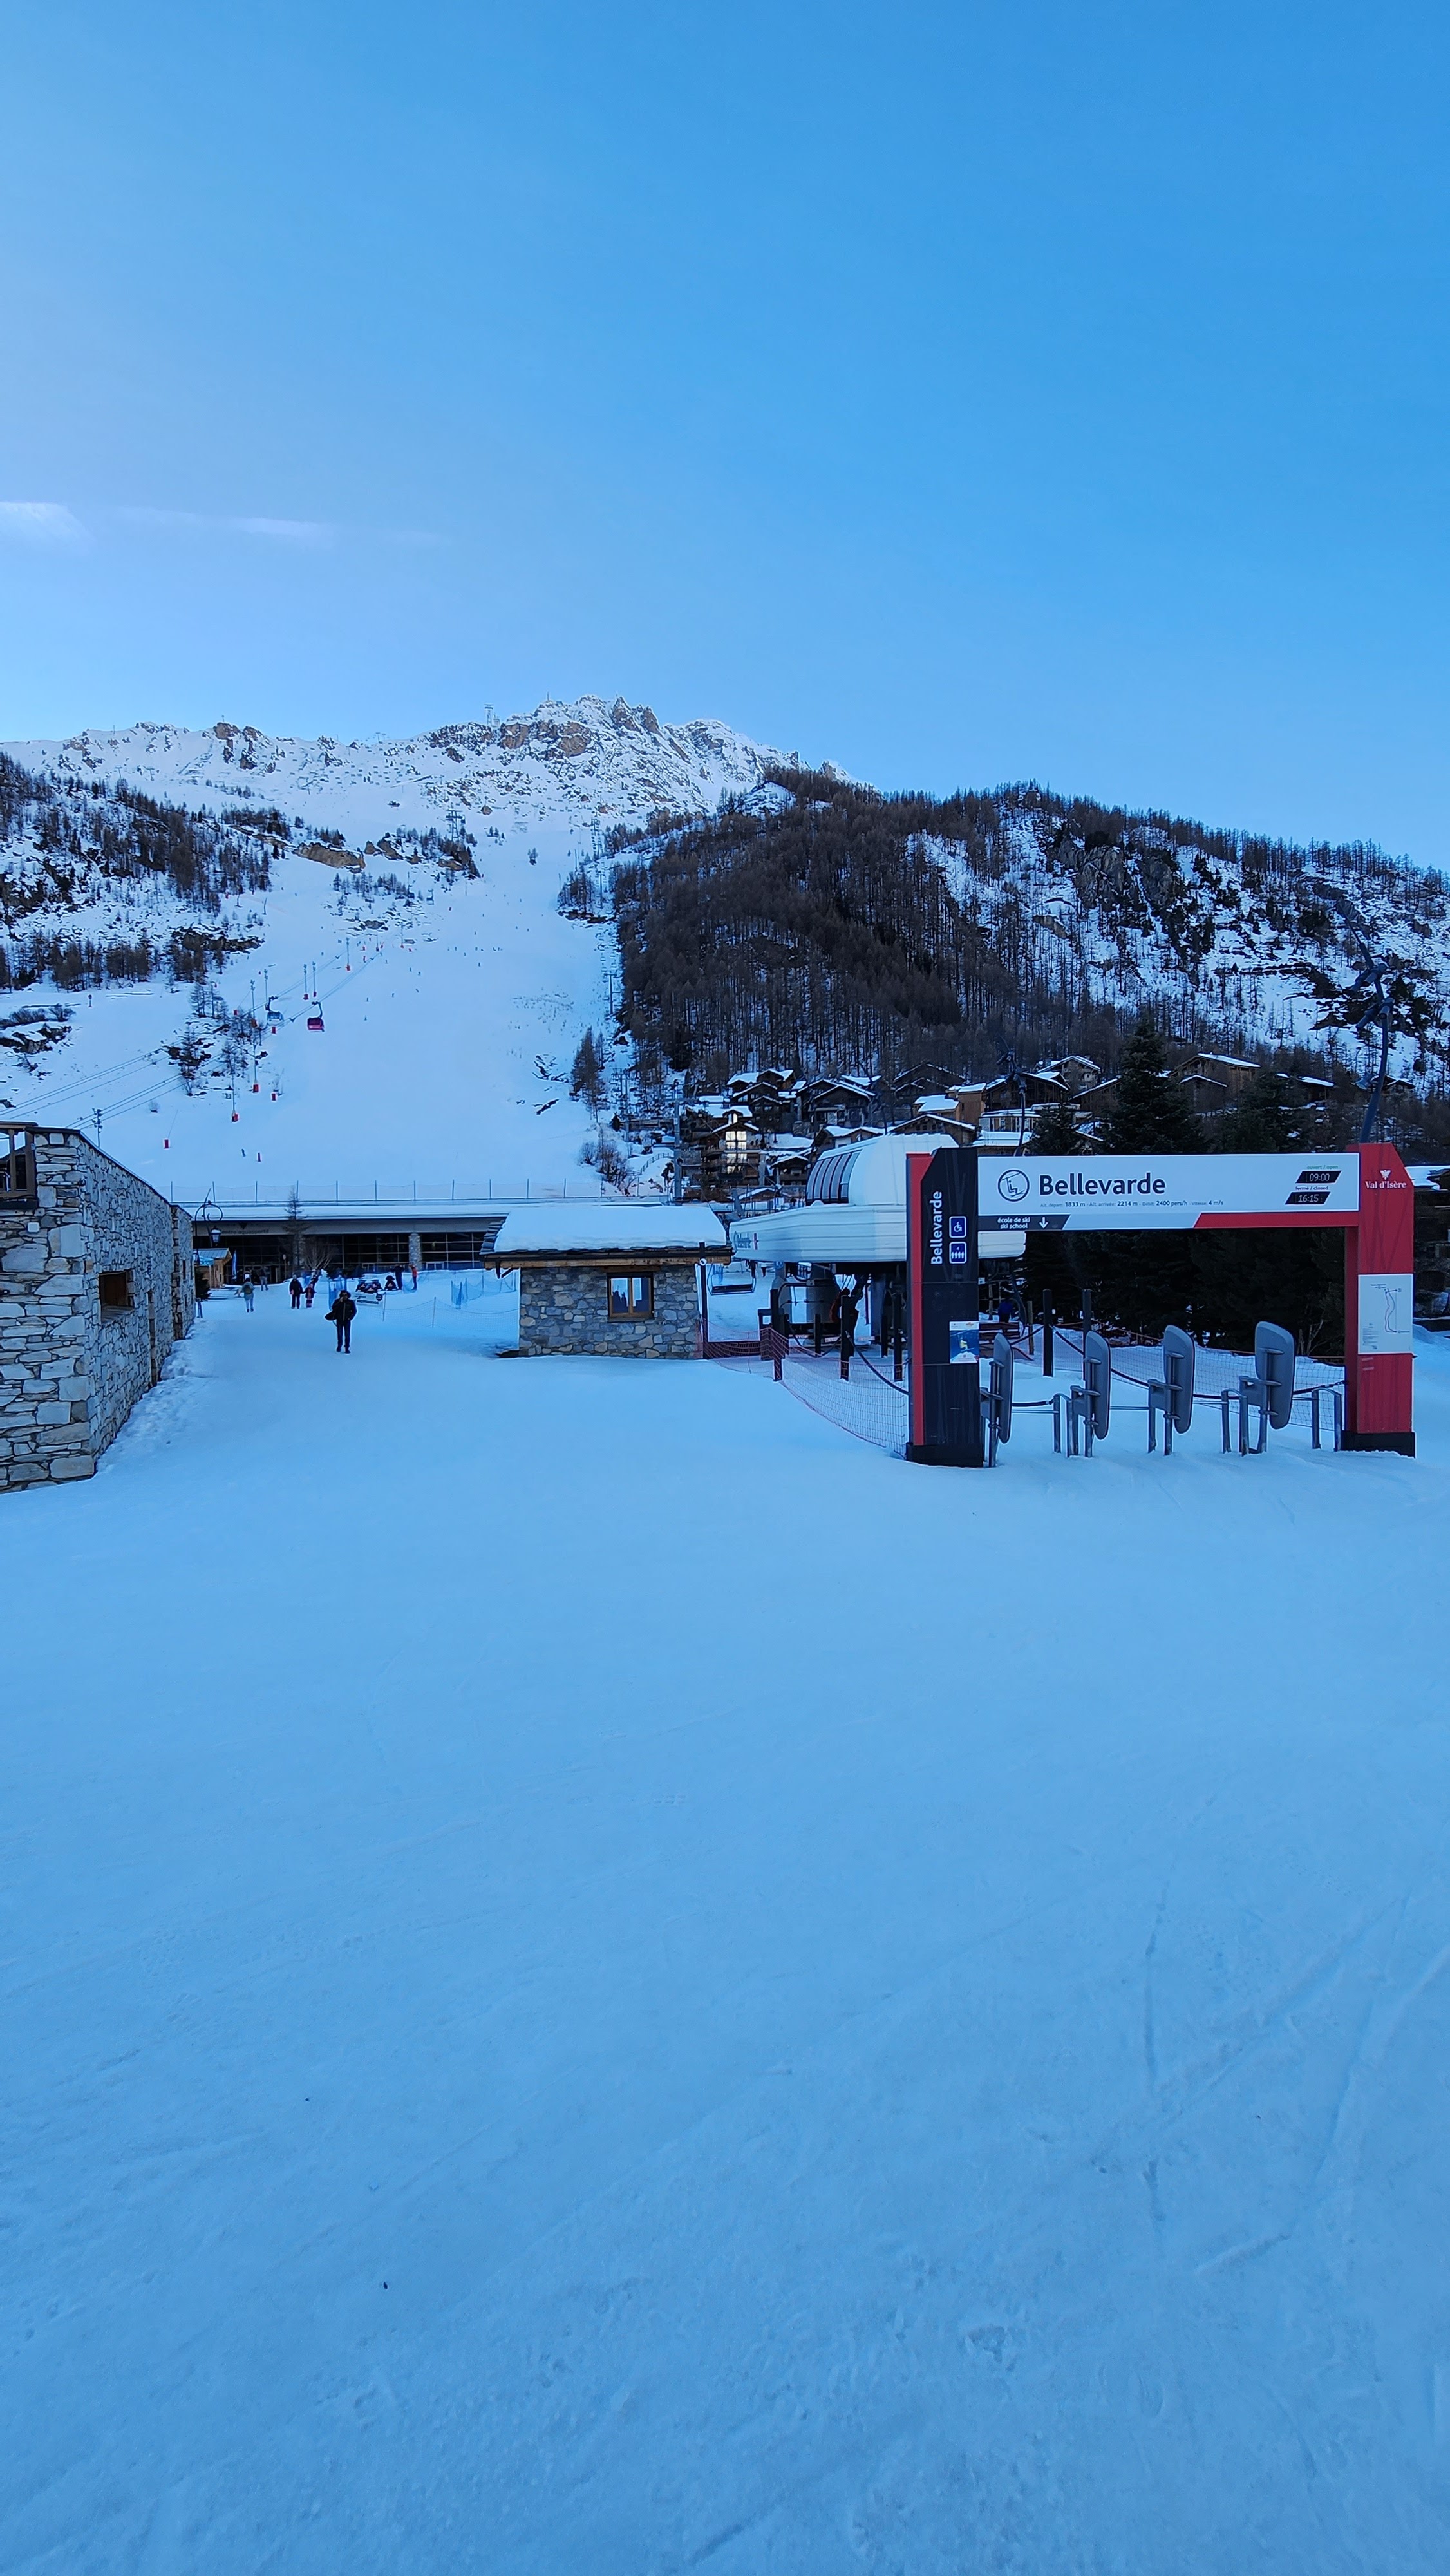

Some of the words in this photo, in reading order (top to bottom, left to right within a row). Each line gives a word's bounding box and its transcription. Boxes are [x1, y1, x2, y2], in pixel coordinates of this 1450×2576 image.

[1040, 1173, 1165, 1195] Bellevarde
[1309, 1173, 1330, 1182] 09:00
[929, 1191, 943, 1264] Bellevarde
